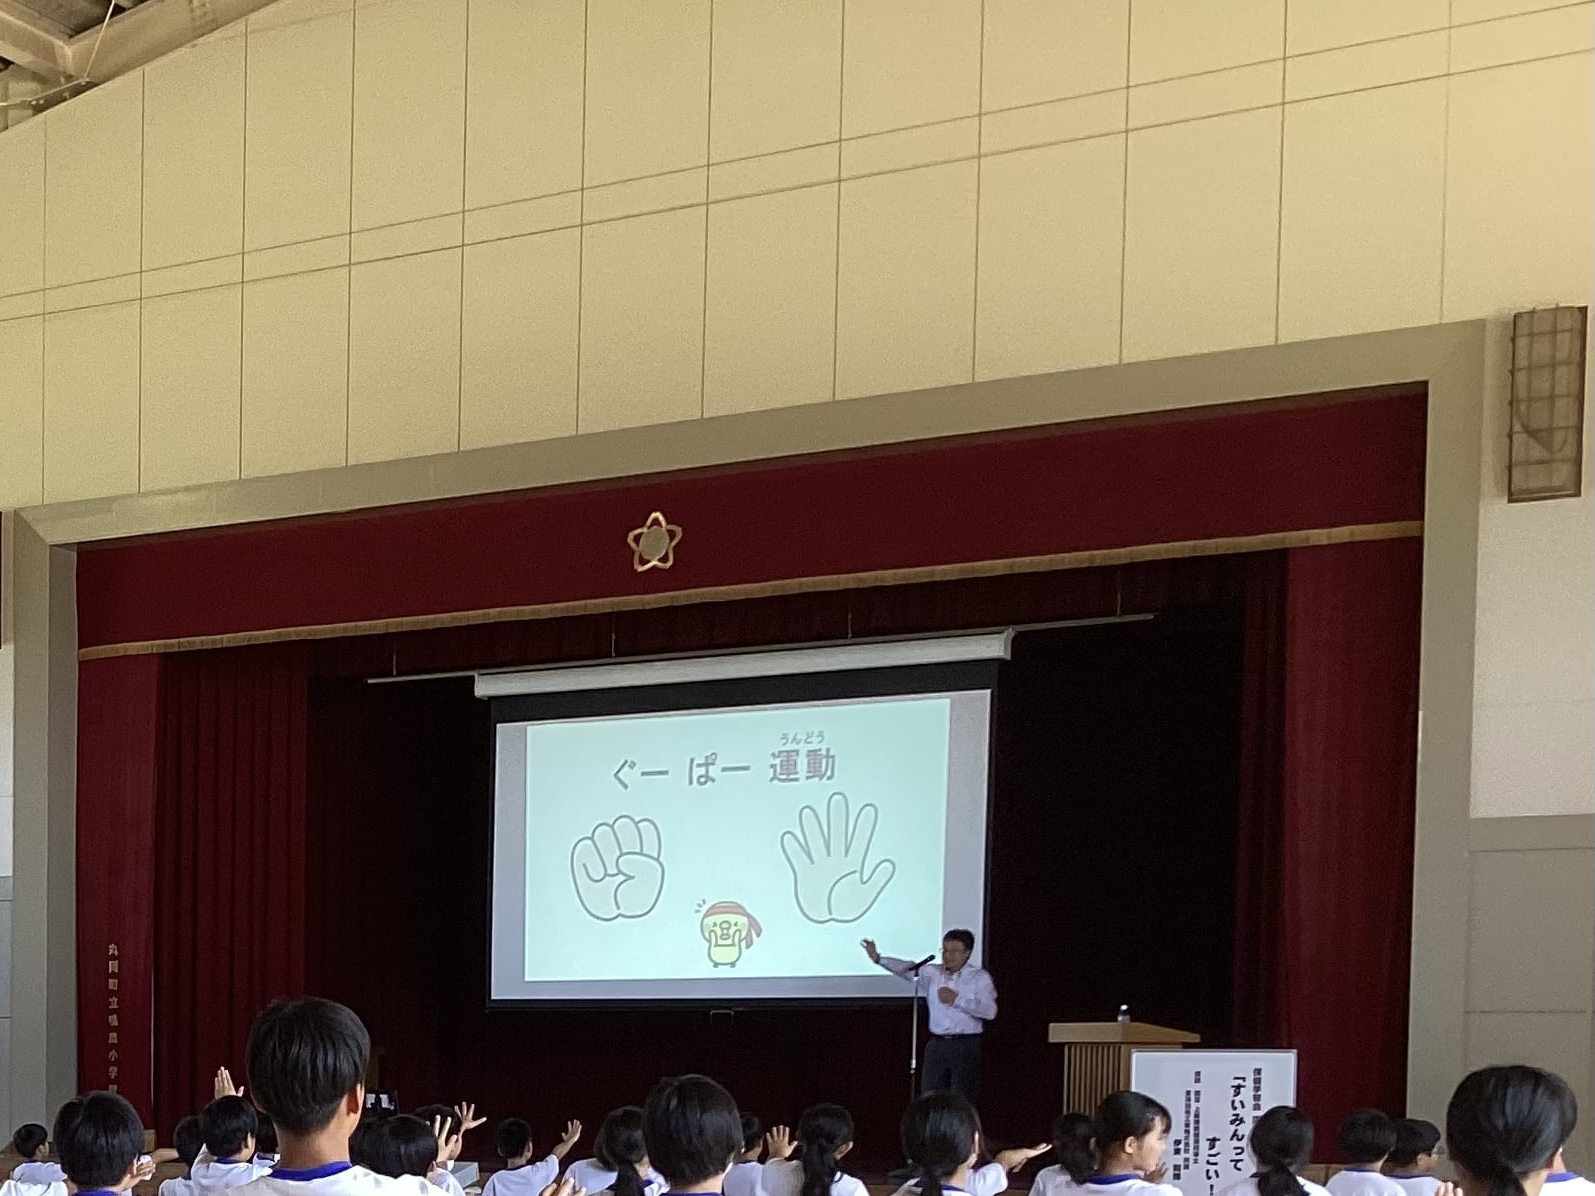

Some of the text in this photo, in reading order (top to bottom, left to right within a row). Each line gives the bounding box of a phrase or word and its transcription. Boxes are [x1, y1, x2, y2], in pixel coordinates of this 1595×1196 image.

[779, 730, 825, 746] うんどう
[613, 747, 836, 790] ぐー ぱー 運動
